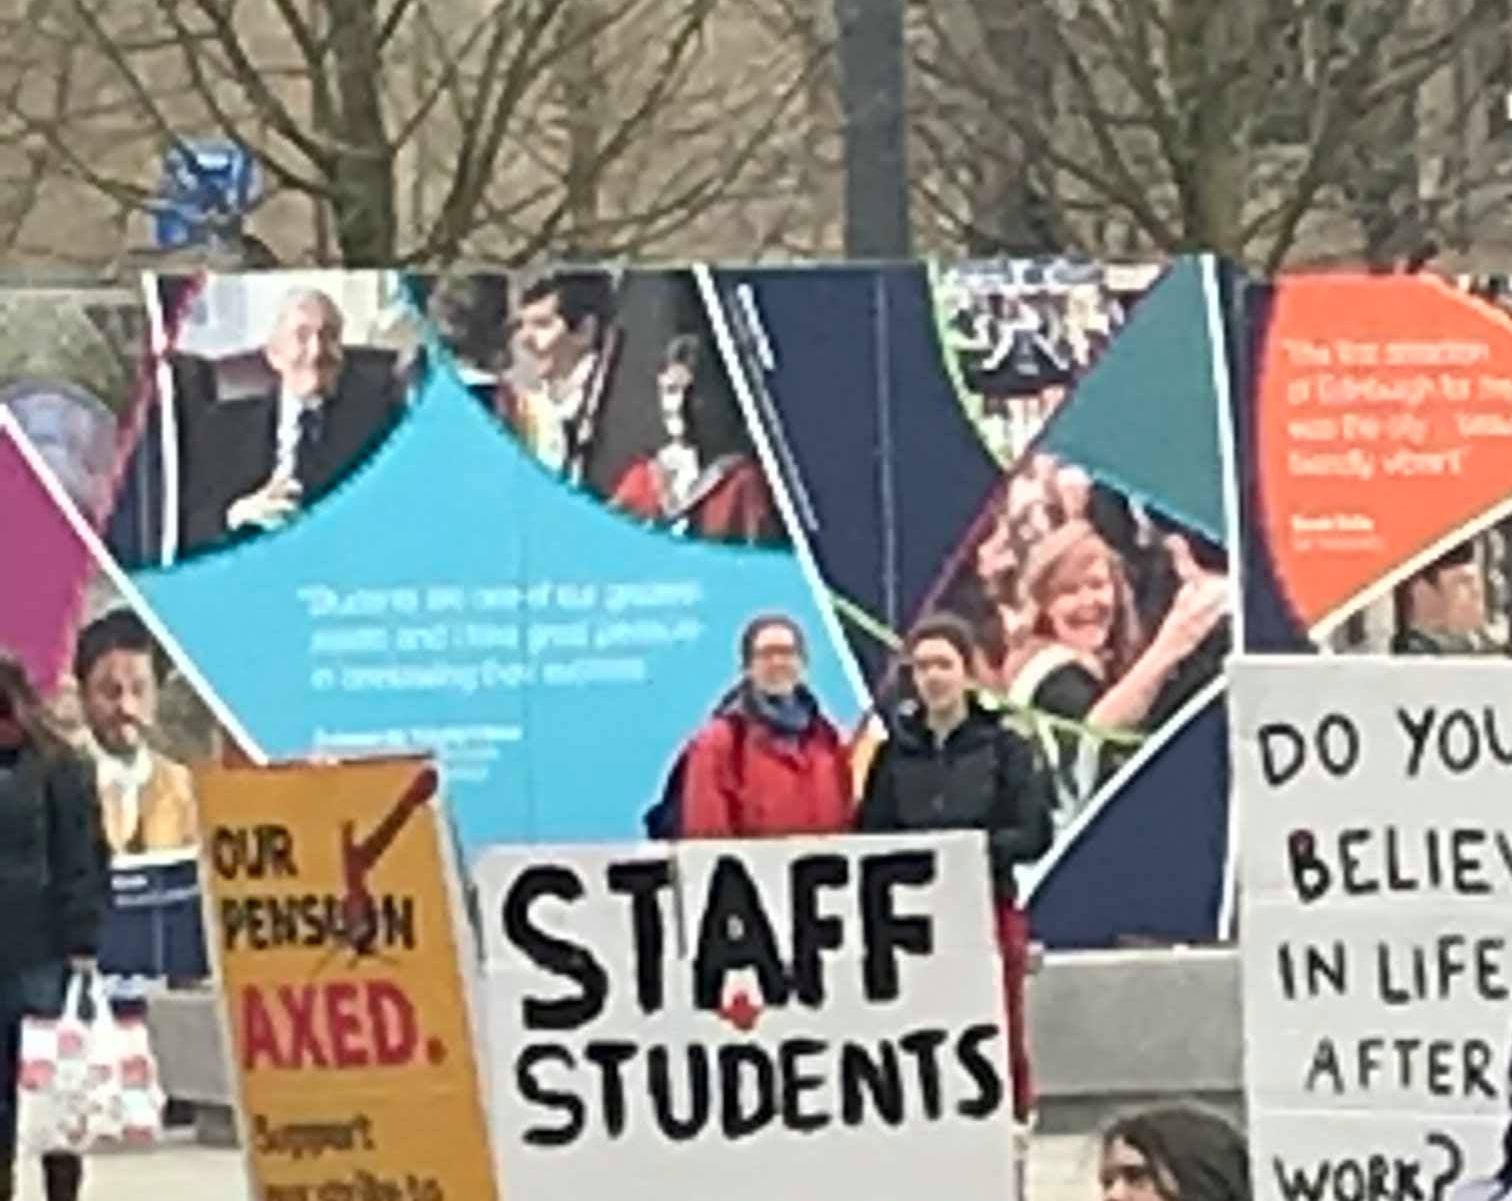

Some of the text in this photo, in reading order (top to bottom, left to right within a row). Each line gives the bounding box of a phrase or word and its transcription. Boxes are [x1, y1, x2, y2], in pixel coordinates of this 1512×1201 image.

[1257, 713, 1360, 787] DO
[211, 824, 298, 880] OUR
[221, 894, 417, 951] PENSION
[502, 850, 937, 1031] STAFF
[1276, 935, 1512, 1005] IN LIFE
[240, 979, 446, 1070] AXED.
[515, 1023, 1005, 1146] STUDENTS
[1304, 1037, 1499, 1099] AFTER
